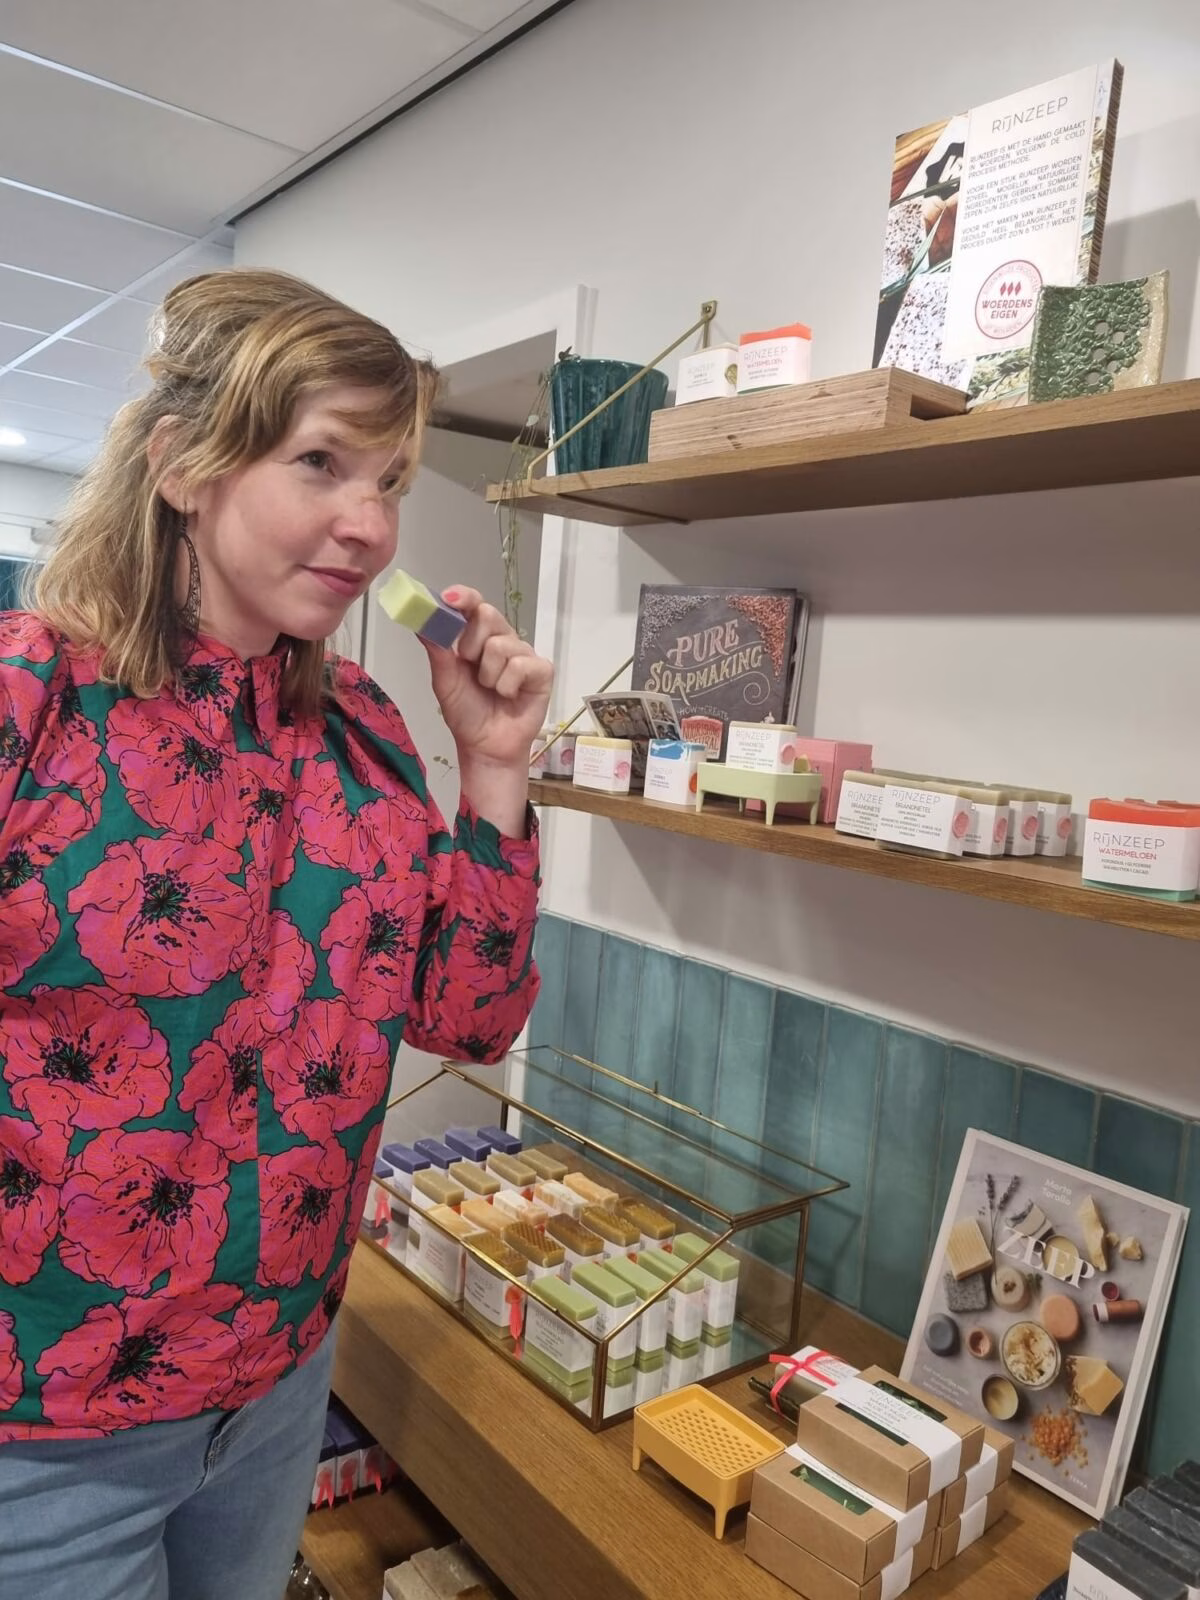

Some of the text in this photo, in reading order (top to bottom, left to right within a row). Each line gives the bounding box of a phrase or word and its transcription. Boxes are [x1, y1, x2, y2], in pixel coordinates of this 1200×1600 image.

[1008, 141, 1020, 151] MET
[1022, 138, 1031, 147] DE
[1033, 131, 1051, 143] HAND
[1054, 120, 1086, 136] GEMAAKT
[980, 152, 1010, 168] WOERDEN
[1016, 142, 1046, 157] VOLGENS
[1051, 137, 1060, 146] DE
[1065, 129, 1085, 141] COLD
[966, 185, 984, 195] VOOR
[986, 180, 998, 189] EEN
[1001, 175, 1016, 185] STUK
[1052, 155, 1082, 169] WORDEN
[968, 164, 996, 178] PROCESS
[1038, 164, 1080, 181] NATUURLIJKE
[1048, 173, 1079, 187] SOMMIGE
[961, 231, 986, 243] GEDULD
[1062, 207, 1076, 216] HET
[962, 224, 980, 235] VOOR
[982, 220, 994, 229] HET
[997, 214, 1019, 225] MAKEN
[1021, 210, 1034, 219] VAN
[960, 238, 984, 251] PROCES
[986, 233, 1007, 246] DUURT
[1032, 224, 1044, 232] TOT
[982, 299, 1033, 309] WOERDENS
[991, 310, 1018, 319] EIGEN
[666, 619, 740, 667] PURE
[645, 646, 763, 705] SOAPMAKING
[851, 802, 880, 813] BRANDNETE
[895, 802, 931, 814] BRANDNETEL
[1099, 847, 1157, 860] WATERMELOEN
[997, 1226, 1095, 1288] ZEEP
